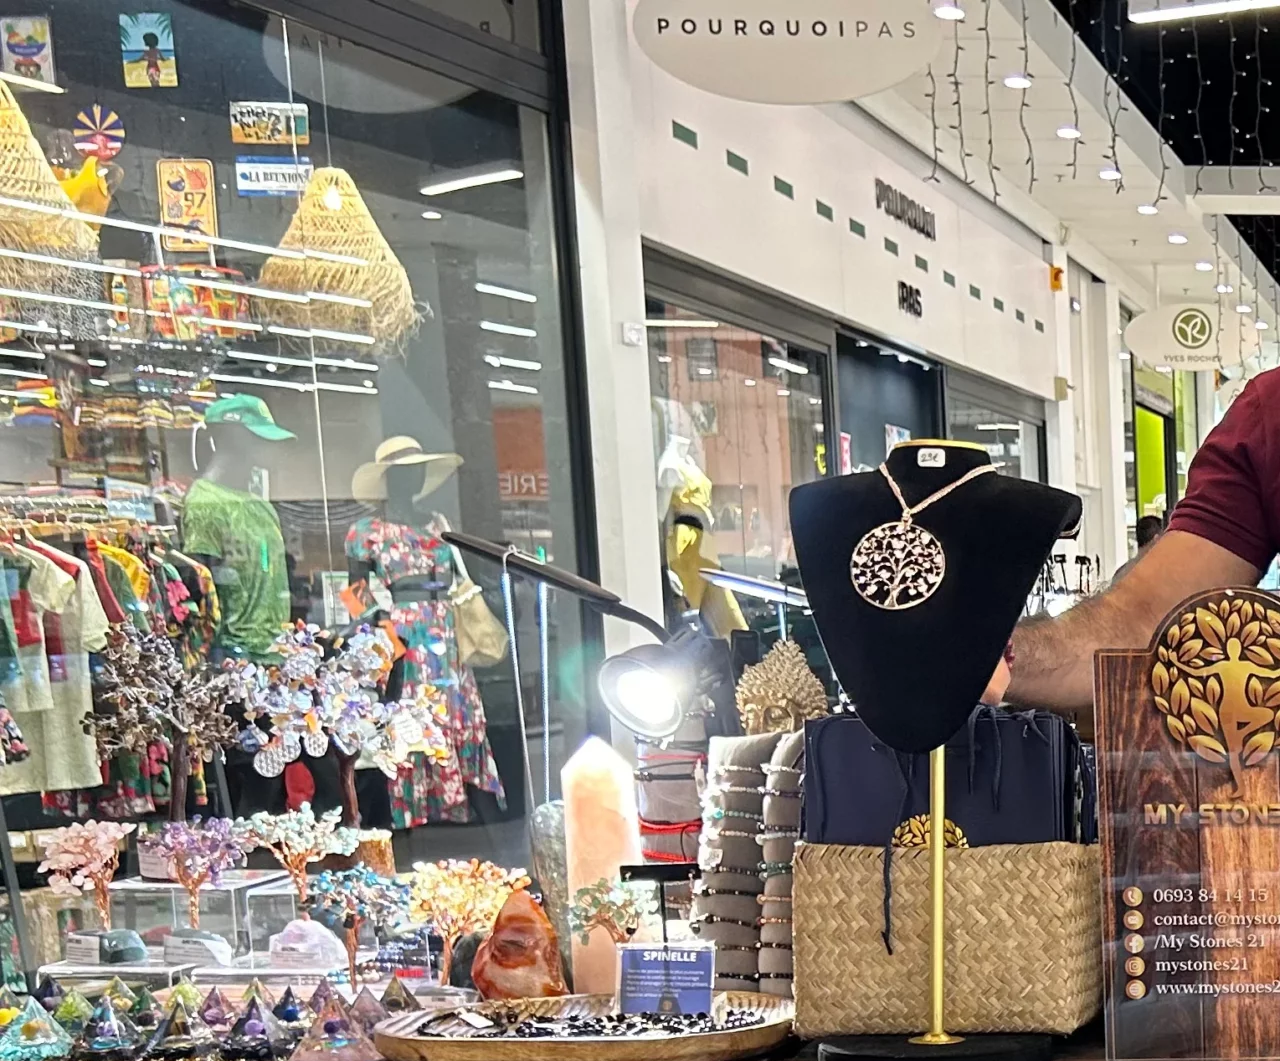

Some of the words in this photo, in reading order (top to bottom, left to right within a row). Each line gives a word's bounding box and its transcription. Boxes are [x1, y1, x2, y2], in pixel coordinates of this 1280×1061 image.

[249, 172, 260, 182] LA
[184, 192, 207, 208] 97
[898, 280, 923, 319] PAS
[1164, 354, 1184, 362] YVES
[1144, 804, 1185, 825] MY
[1154, 888, 1193, 903] 0693
[1198, 888, 1218, 902] 84
[1224, 888, 1242, 902] 14
[1249, 888, 1269, 902] 15
[1154, 934, 1185, 951] /My
[1190, 934, 1244, 949] Stones
[1247, 934, 1266, 948] 21
[643, 951, 697, 962] SPINELLE
[1155, 958, 1248, 974] mystones21
